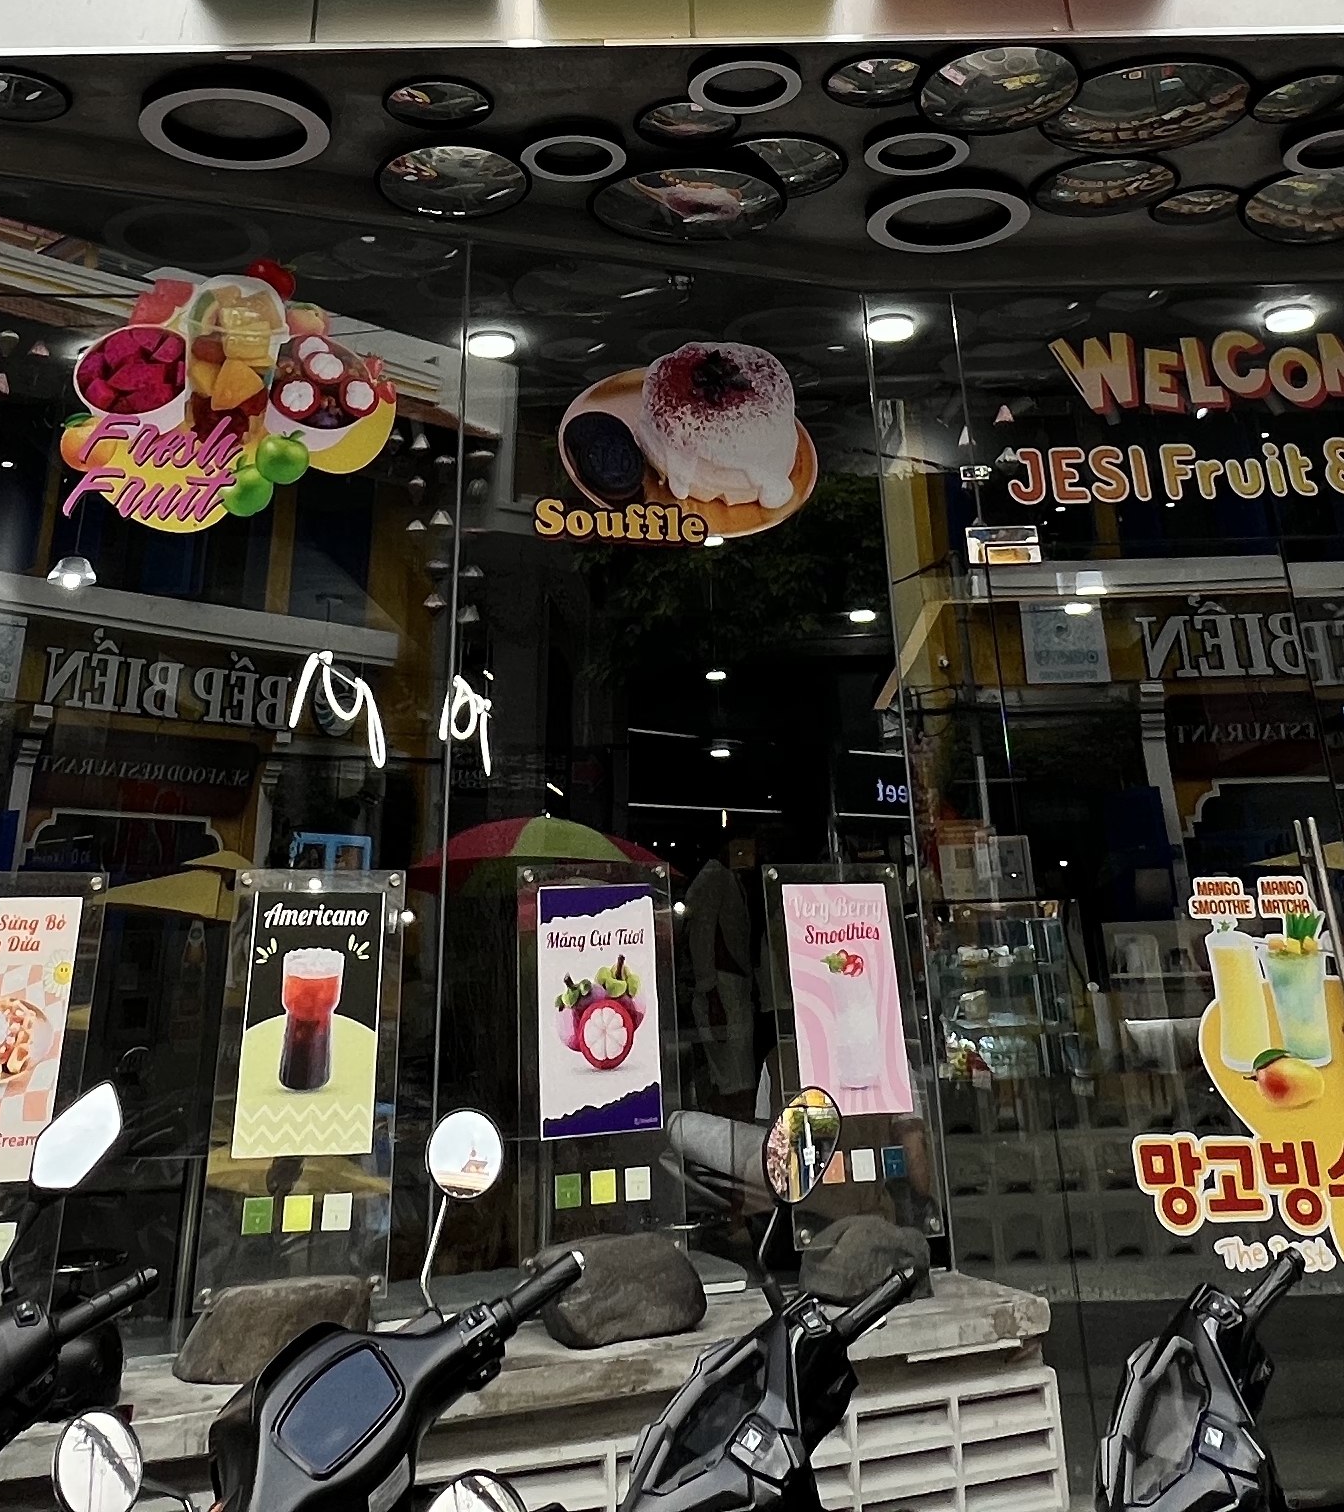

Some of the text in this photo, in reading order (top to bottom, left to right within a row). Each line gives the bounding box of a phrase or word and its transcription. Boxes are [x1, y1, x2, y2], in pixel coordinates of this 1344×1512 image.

[79, 414, 244, 471] Fresh
[1008, 444, 1152, 506] JESI
[1158, 441, 1319, 500] Fruit
[62, 465, 238, 524] Fruit
[534, 497, 709, 546] Souffle
[1196, 880, 1242, 897] MANGO
[1260, 880, 1304, 896] MANGO
[263, 902, 371, 929] Americano
[788, 895, 884, 926] Very Berry
[1192, 899, 1254, 916] SMOOTHIE
[1261, 899, 1311, 915] MATCHA
[45, 914, 67, 932] Bò
[804, 923, 881, 947] Smoothies
[8, 934, 42, 953] Dừa
[546, 930, 586, 953] Măng
[1219, 1241, 1263, 1268] The
